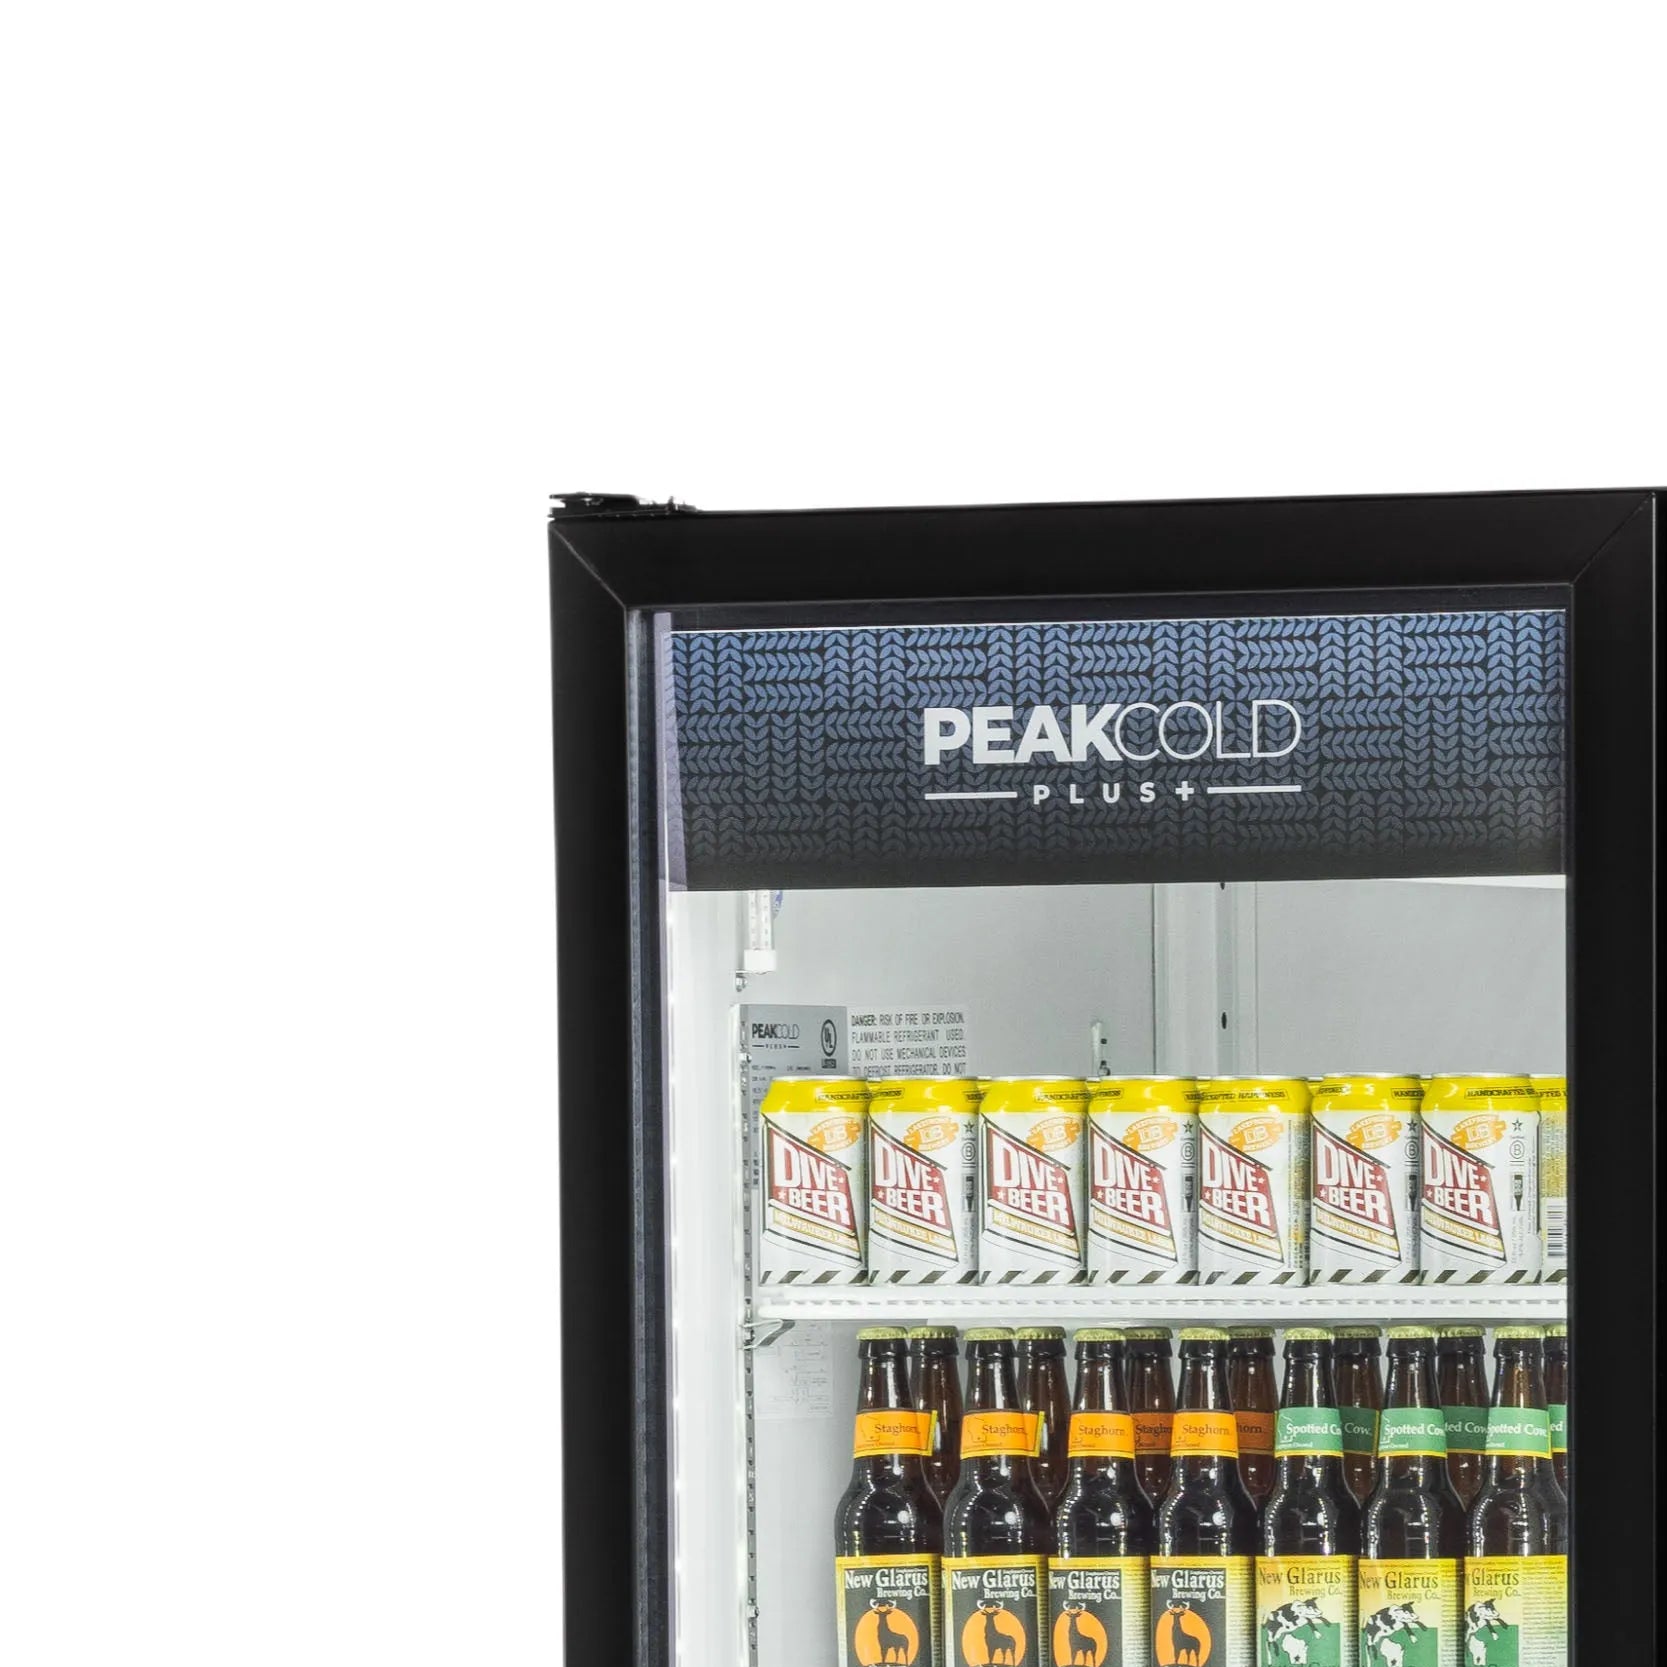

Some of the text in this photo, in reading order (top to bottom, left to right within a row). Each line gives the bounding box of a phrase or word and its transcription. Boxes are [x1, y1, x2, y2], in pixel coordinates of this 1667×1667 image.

[924, 698, 1302, 765] PEAKCOLD
[852, 1031, 890, 1043] FLAMMABLE
[894, 1029, 939, 1042] REFRIGERANT
[880, 1014, 892, 1025] RISK
[895, 1014, 903, 1024] OF
[905, 1014, 917, 1024] FIRE
[922, 1013, 930, 1024] OR
[853, 1046, 966, 1060] DO NOT USE MECHANICAL DEVICES
[943, 1063, 951, 1074] DO
[954, 1063, 966, 1073] NOT
[773, 1144, 838, 1189] DIVE
[874, 1142, 933, 1190] DIVE
[992, 1142, 1056, 1189] DIVE
[1203, 1142, 1255, 1187] DIVE
[1318, 1141, 1375, 1188] DIVE
[1425, 1141, 1477, 1188] DIVE
[789, 1189, 849, 1226] BEER
[885, 1189, 943, 1225] BEER
[1008, 1190, 1068, 1226] BEER
[1213, 1188, 1269, 1225] BEER
[1330, 1187, 1388, 1224] BEER
[1436, 1187, 1492, 1224] BEER
[1286, 1423, 1327, 1437] Spotted
[845, 1569, 928, 1589] New Glarus
[877, 1587, 912, 1600] Brewing
[953, 1570, 1035, 1590] New Glarus
[1067, 1571, 1119, 1589] Glarus
[1287, 1567, 1340, 1585] Glarus
[1385, 1571, 1438, 1588] Glarus
